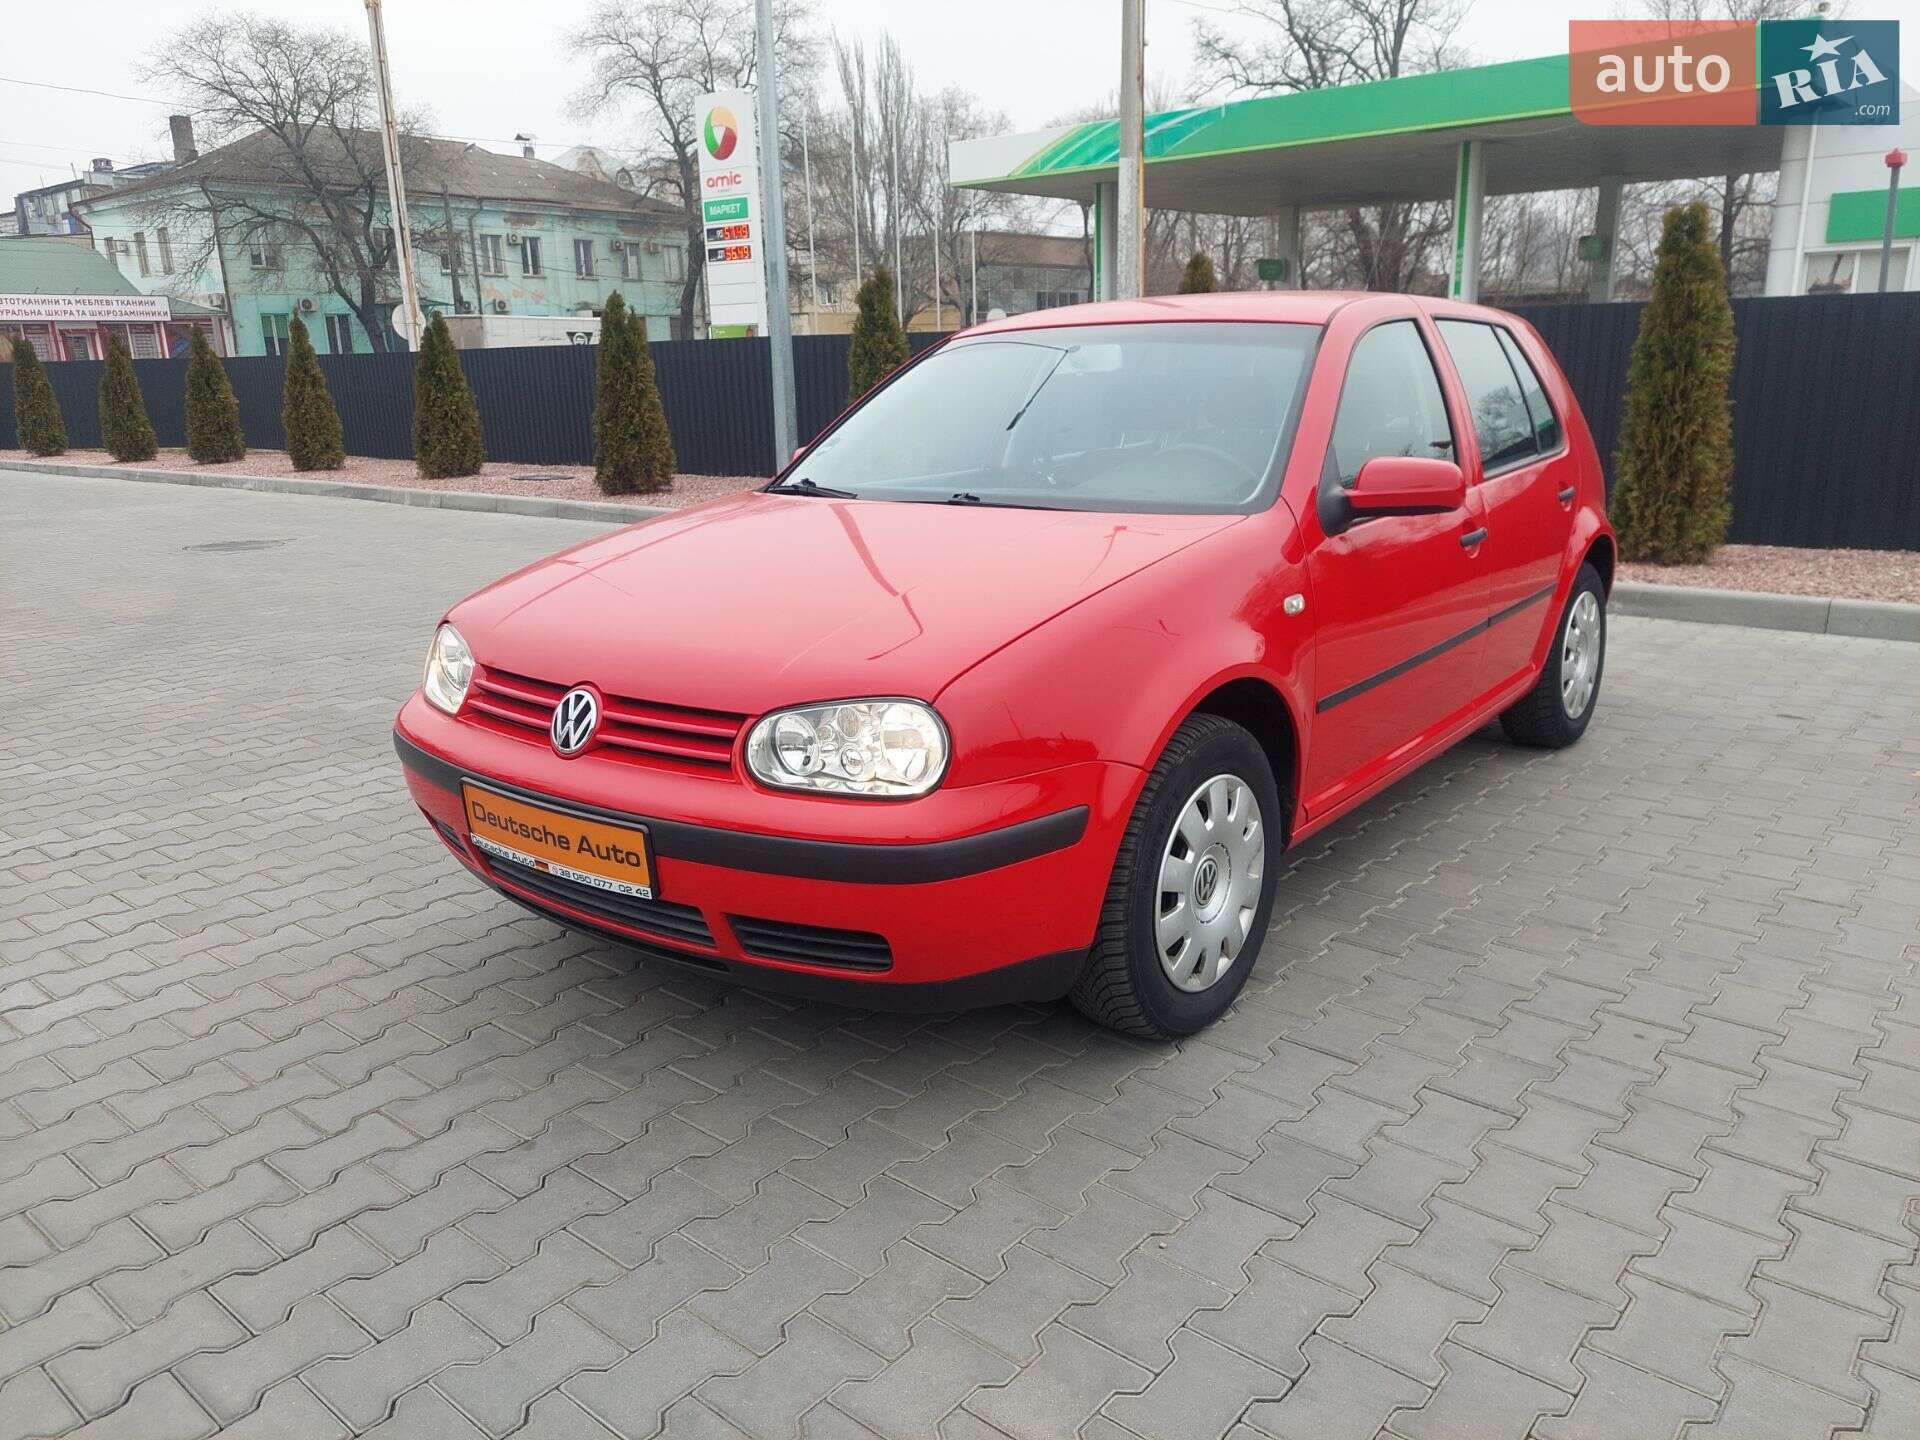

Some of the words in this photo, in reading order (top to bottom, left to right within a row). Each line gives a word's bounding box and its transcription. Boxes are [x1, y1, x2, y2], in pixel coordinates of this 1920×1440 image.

[706, 171, 742, 188] amic
[709, 203, 742, 216] МАРКЕТ
[62, 298, 73, 306] ТА
[75, 298, 114, 307] МЕБЛЕВІ
[116, 299, 156, 307] ТКАНИНИ
[45, 309, 75, 317] ШКІРА
[76, 309, 87, 317] ТА
[88, 309, 169, 317] ШКІРОЗАМІННИКИ
[472, 801, 570, 850] Deutsche
[576, 835, 641, 868] Auto
[512, 852, 535, 867] Auto
[618, 884, 633, 893] 02
[635, 889, 650, 898] 42
